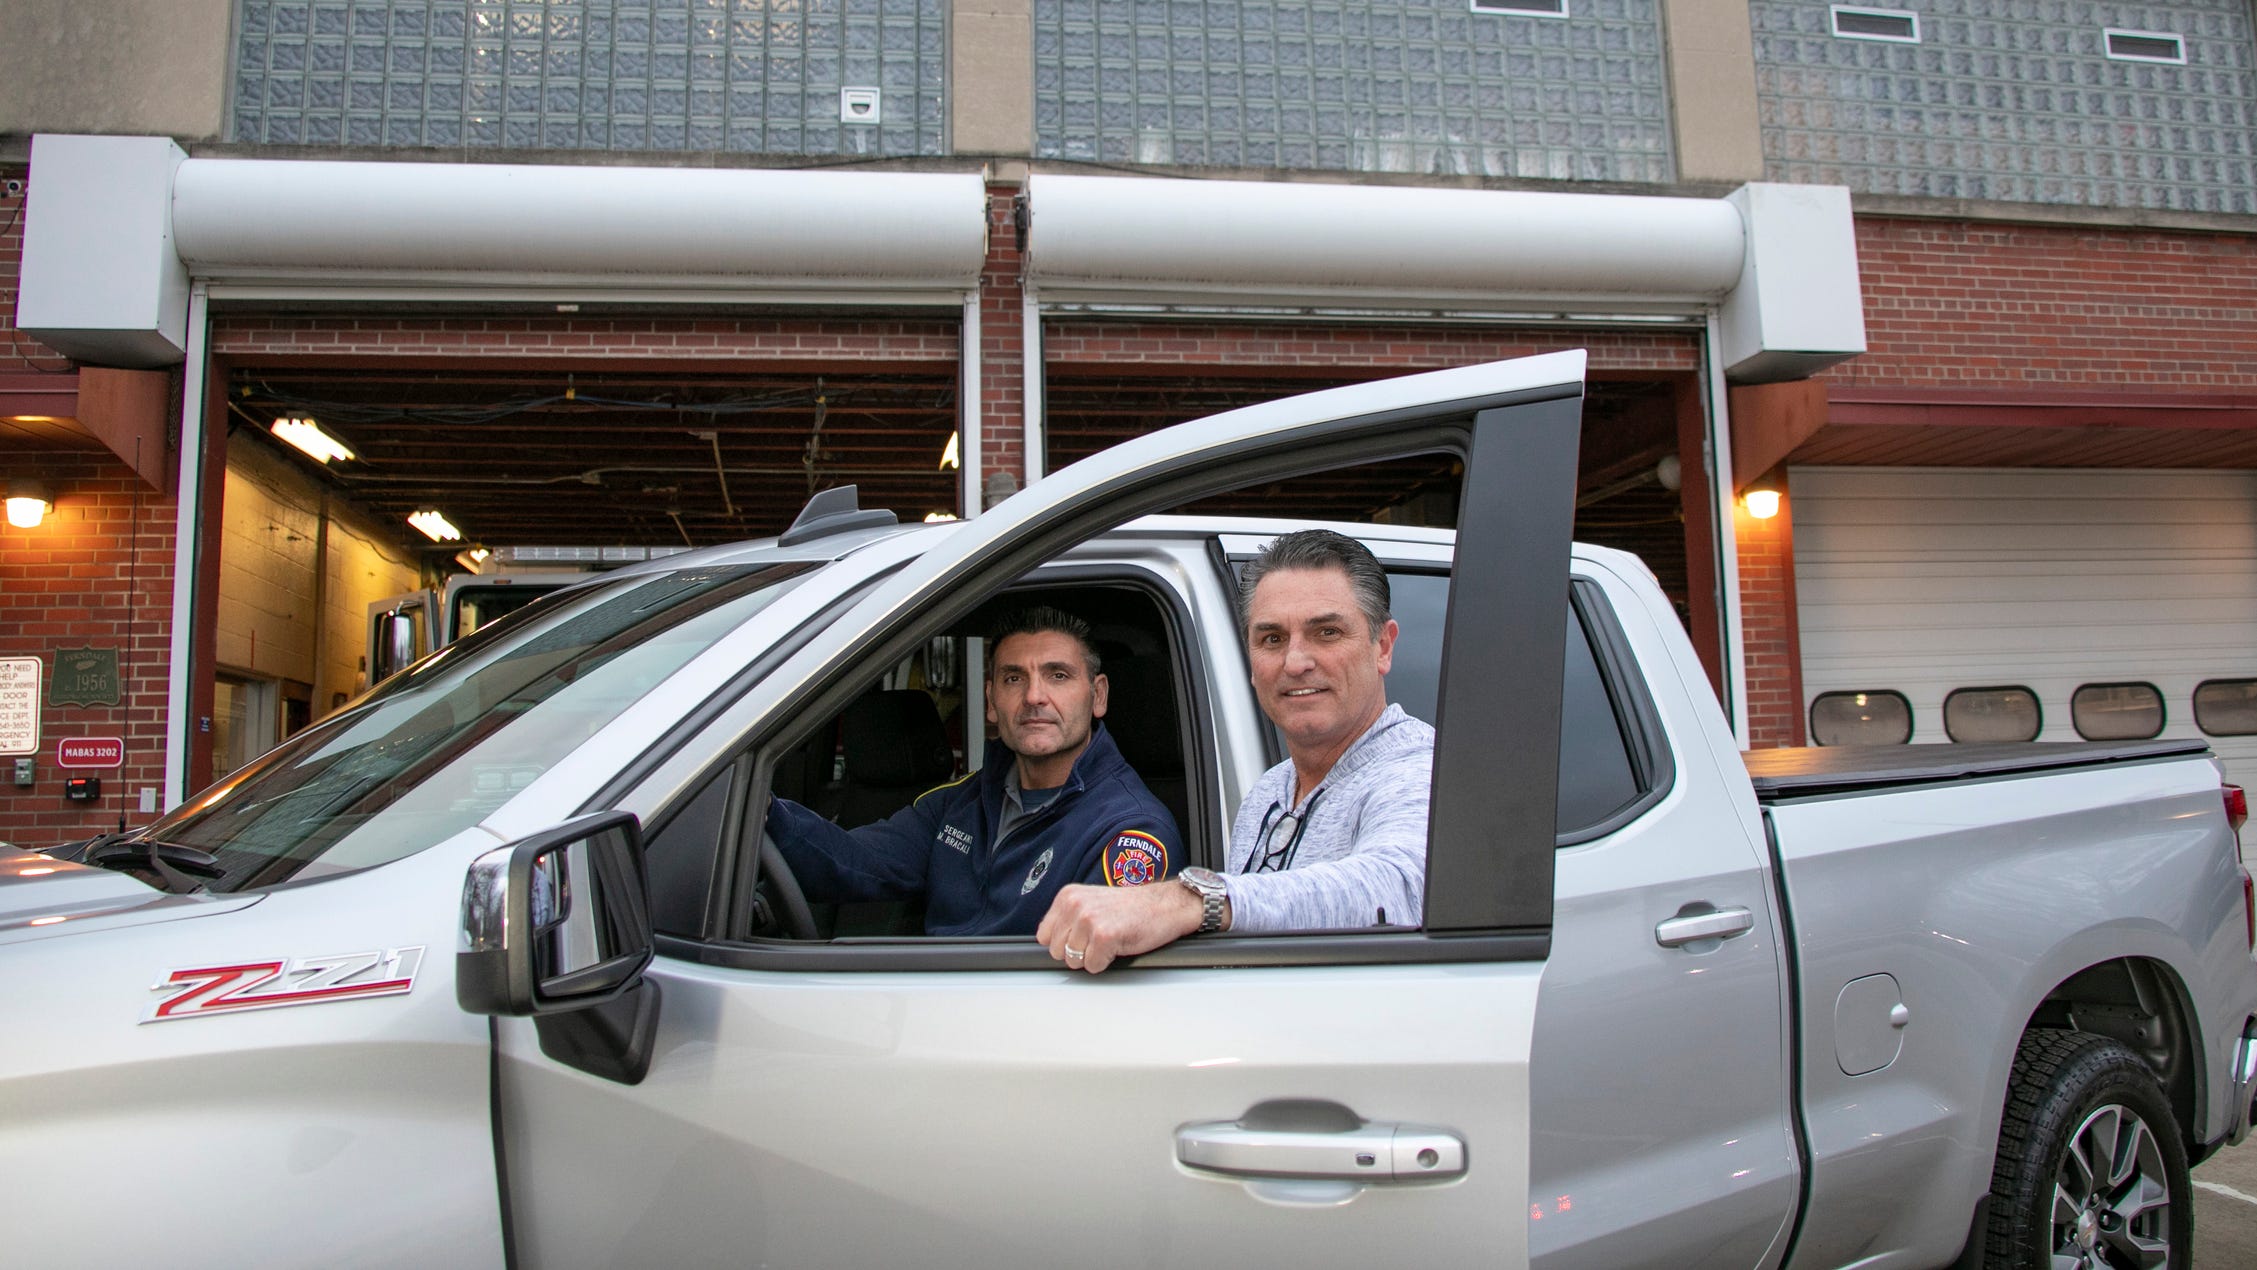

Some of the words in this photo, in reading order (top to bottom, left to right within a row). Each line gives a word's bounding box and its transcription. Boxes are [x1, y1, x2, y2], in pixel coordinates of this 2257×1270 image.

[14, 663, 31, 672] NEED
[76, 674, 107, 691] 1956
[65, 747, 95, 757] MABAS
[96, 747, 118, 757] 3202
[943, 824, 974, 845] SERGEANT
[1117, 836, 1162, 862] FERNDALE
[1130, 851, 1149, 862] FIRE
[137, 944, 427, 1025] Z71
